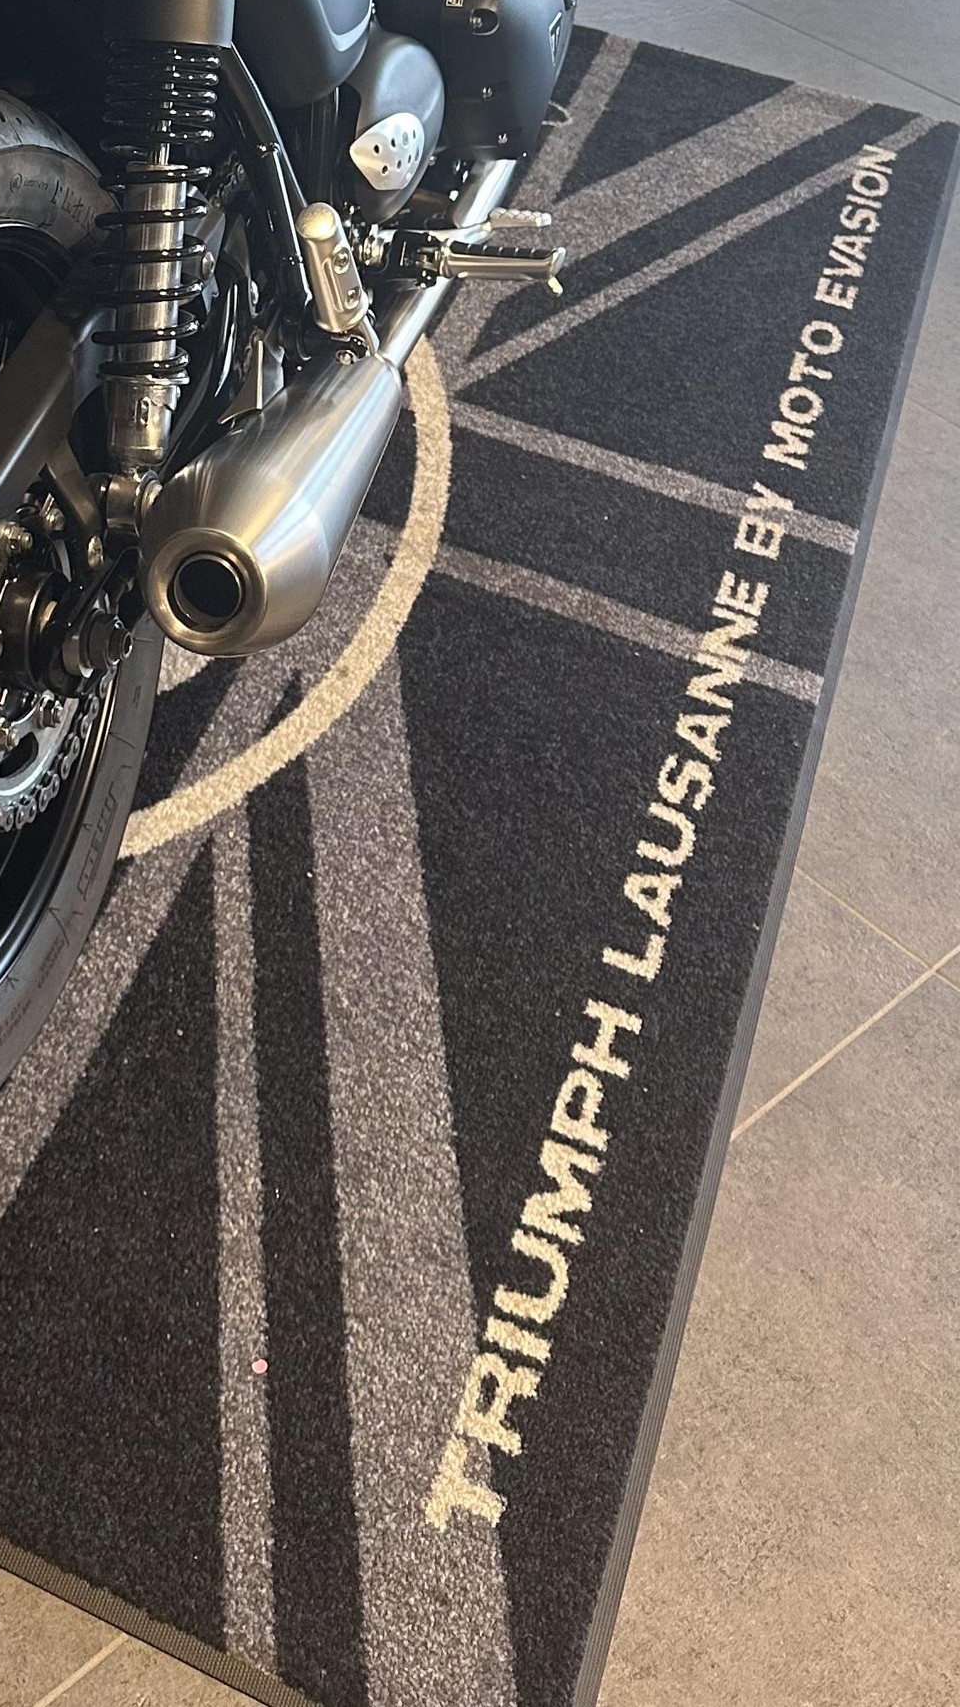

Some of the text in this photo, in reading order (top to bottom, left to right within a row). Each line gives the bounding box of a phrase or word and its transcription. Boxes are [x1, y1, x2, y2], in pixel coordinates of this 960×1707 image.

[425, 144, 898, 1532] TRIUMPH LAUSANNE BY MOTO EVASION
